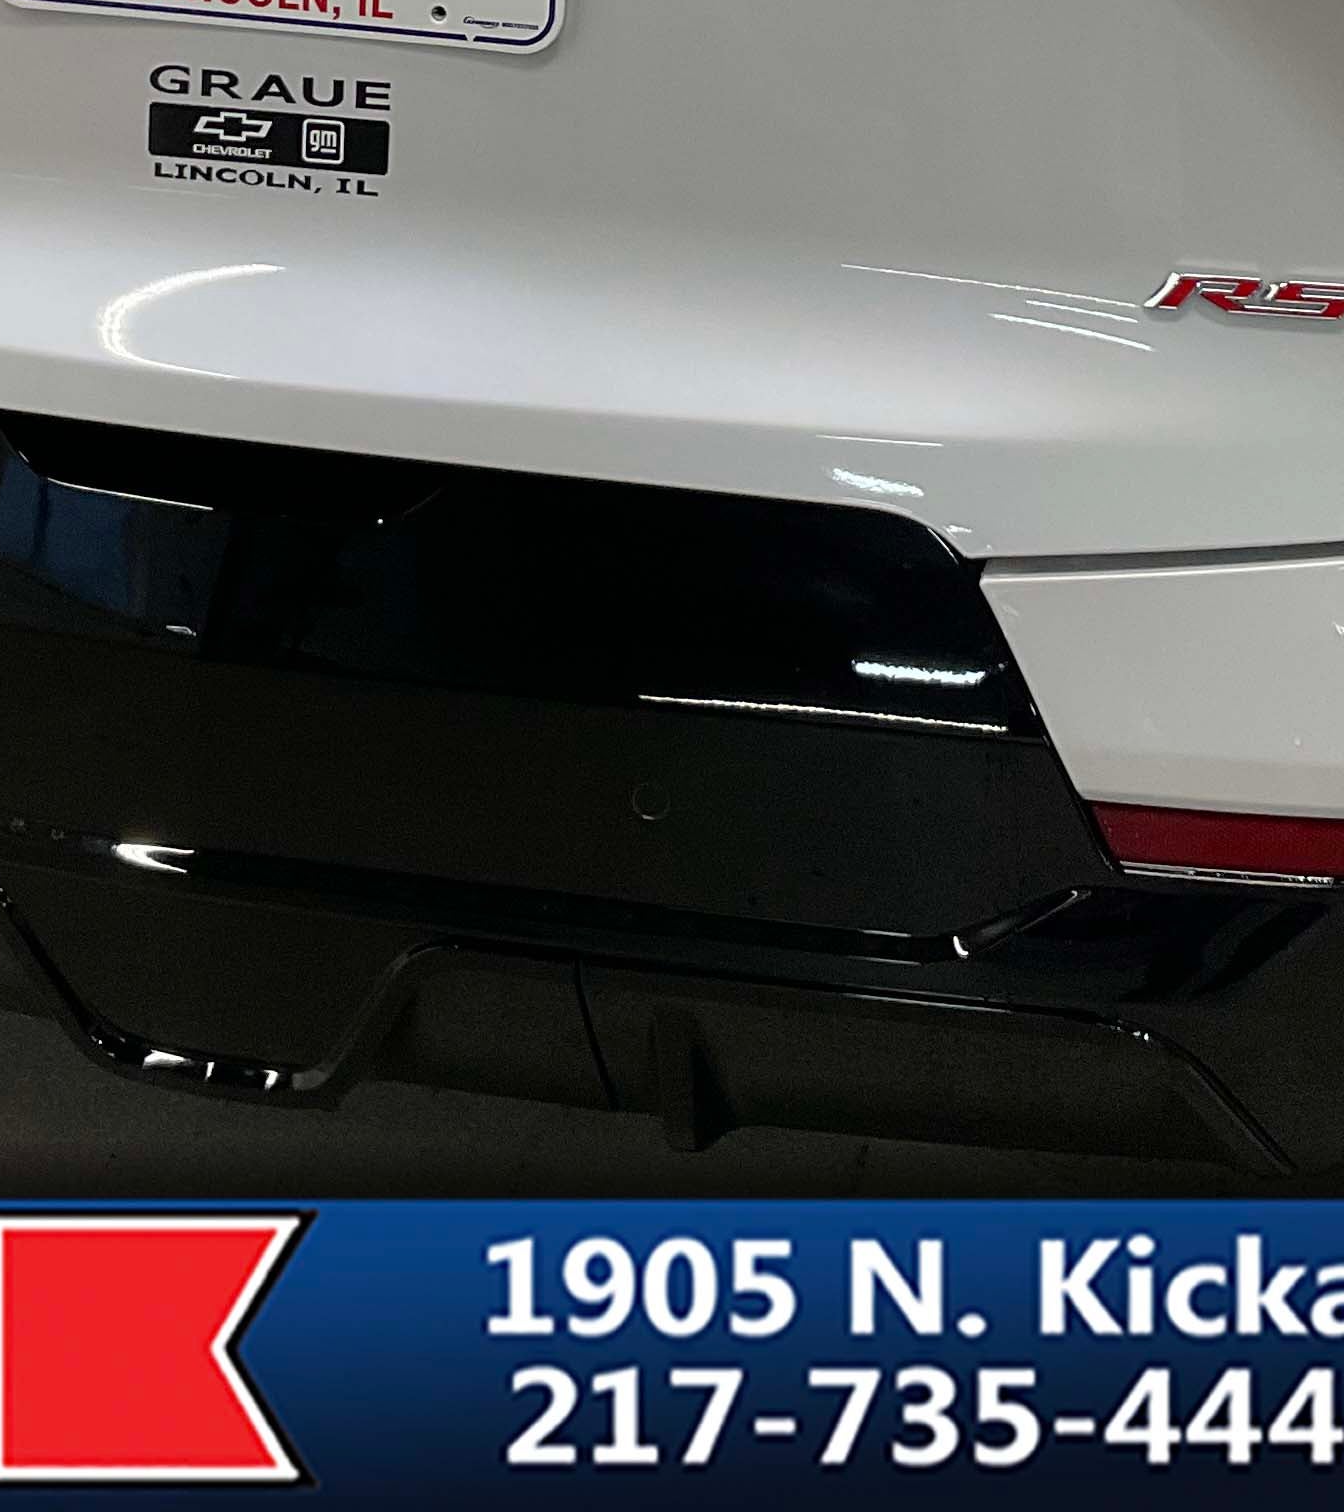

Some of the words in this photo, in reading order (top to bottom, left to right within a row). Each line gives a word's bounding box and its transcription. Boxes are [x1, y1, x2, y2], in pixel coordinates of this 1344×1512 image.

[149, 64, 391, 111] GRAUE
[192, 143, 273, 159] CHEVROLET
[154, 162, 322, 194] LINCOLN,
[336, 178, 379, 197] IL
